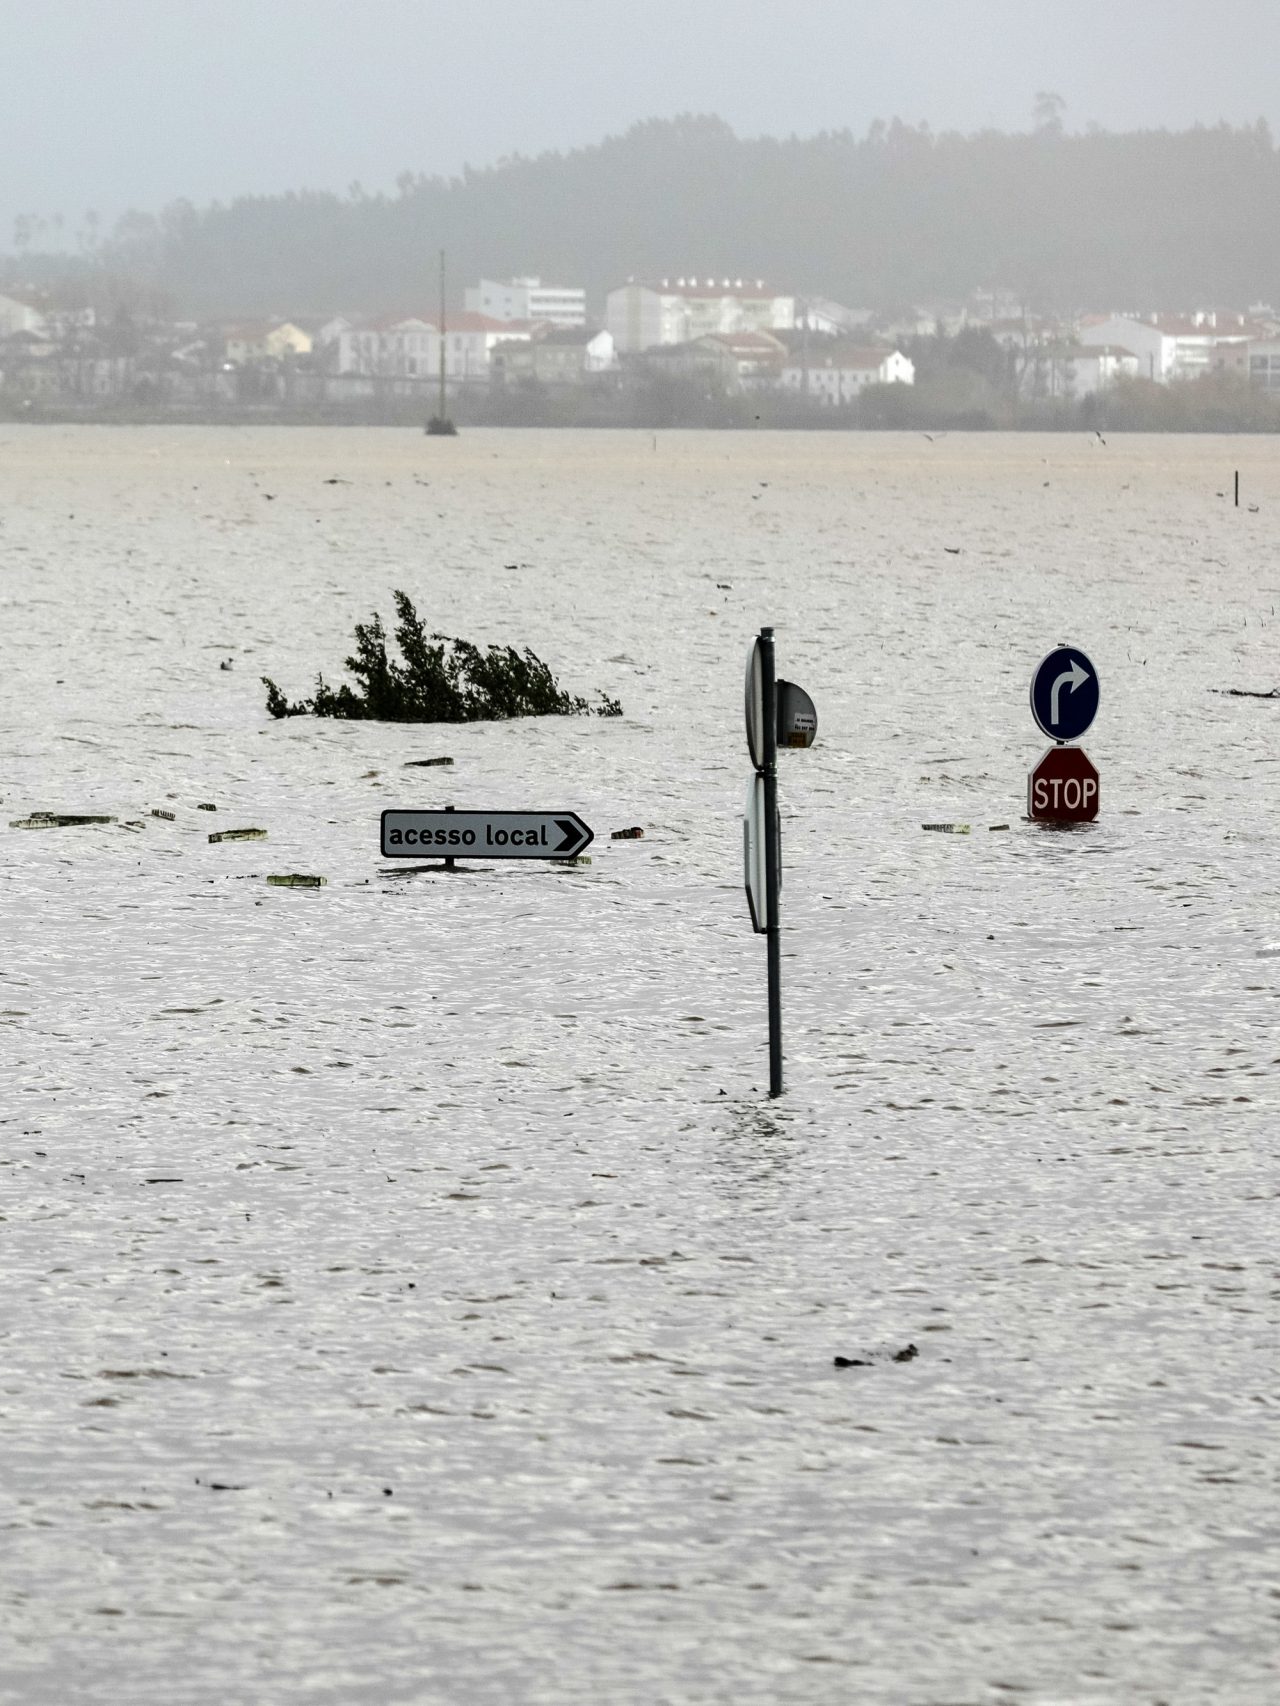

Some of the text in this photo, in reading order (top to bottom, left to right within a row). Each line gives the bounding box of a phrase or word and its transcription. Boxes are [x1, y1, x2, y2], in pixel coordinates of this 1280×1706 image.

[1034, 778, 1097, 809] STOP
[389, 824, 548, 846] acesso local
